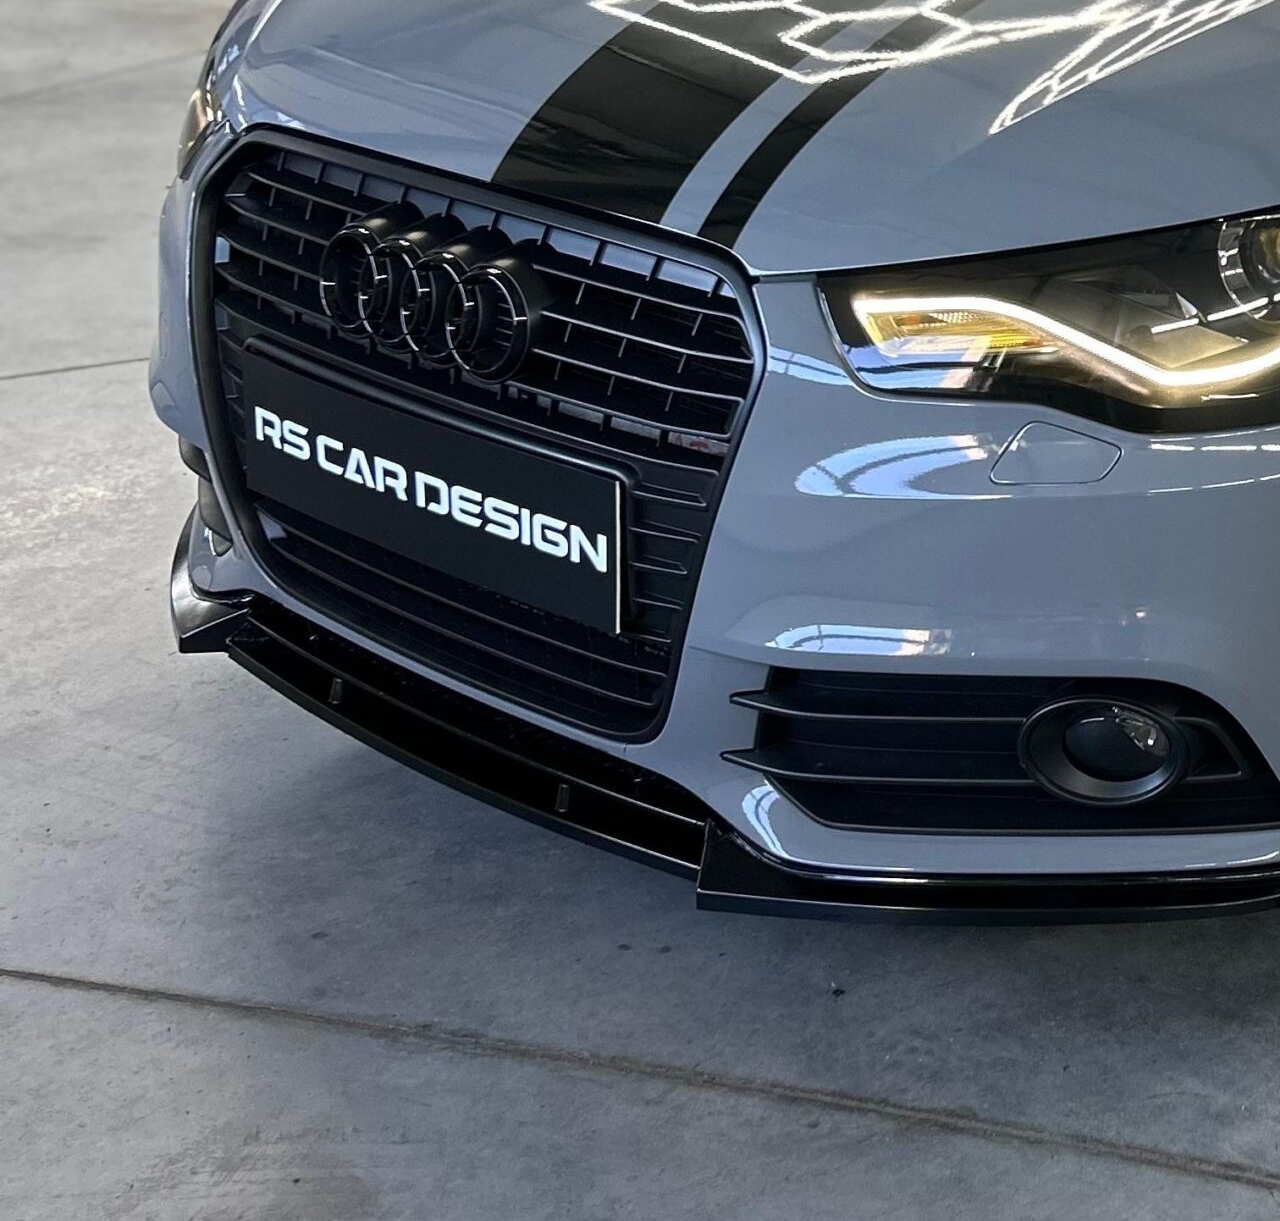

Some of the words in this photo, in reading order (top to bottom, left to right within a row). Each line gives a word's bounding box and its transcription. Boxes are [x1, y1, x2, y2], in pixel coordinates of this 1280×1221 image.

[254, 406, 310, 461] RS
[315, 434, 408, 502] CAR
[414, 470, 608, 573] DESIGN
